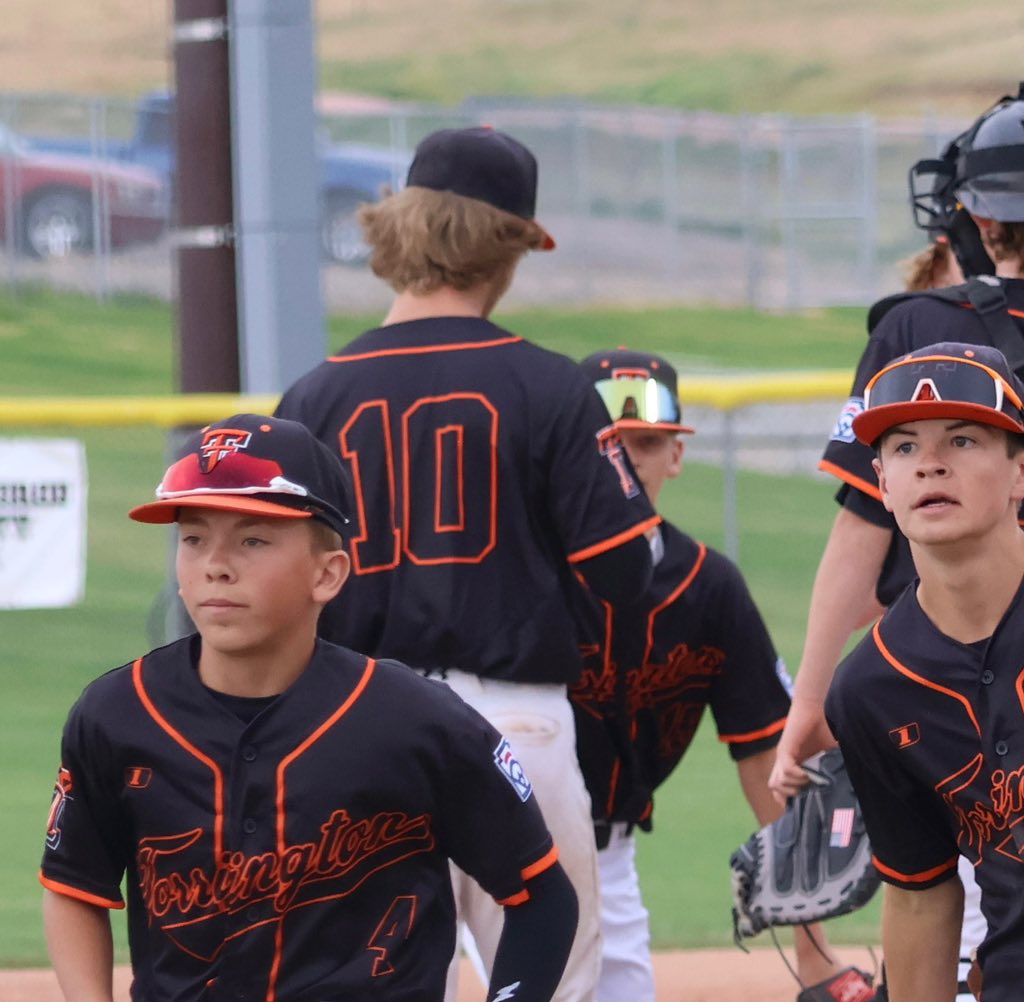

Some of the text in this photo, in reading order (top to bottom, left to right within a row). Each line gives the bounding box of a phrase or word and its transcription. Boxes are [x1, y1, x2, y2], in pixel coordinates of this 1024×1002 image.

[339, 392, 499, 576] 10
[138, 808, 433, 928] Torrington
[367, 895, 418, 978] 4
